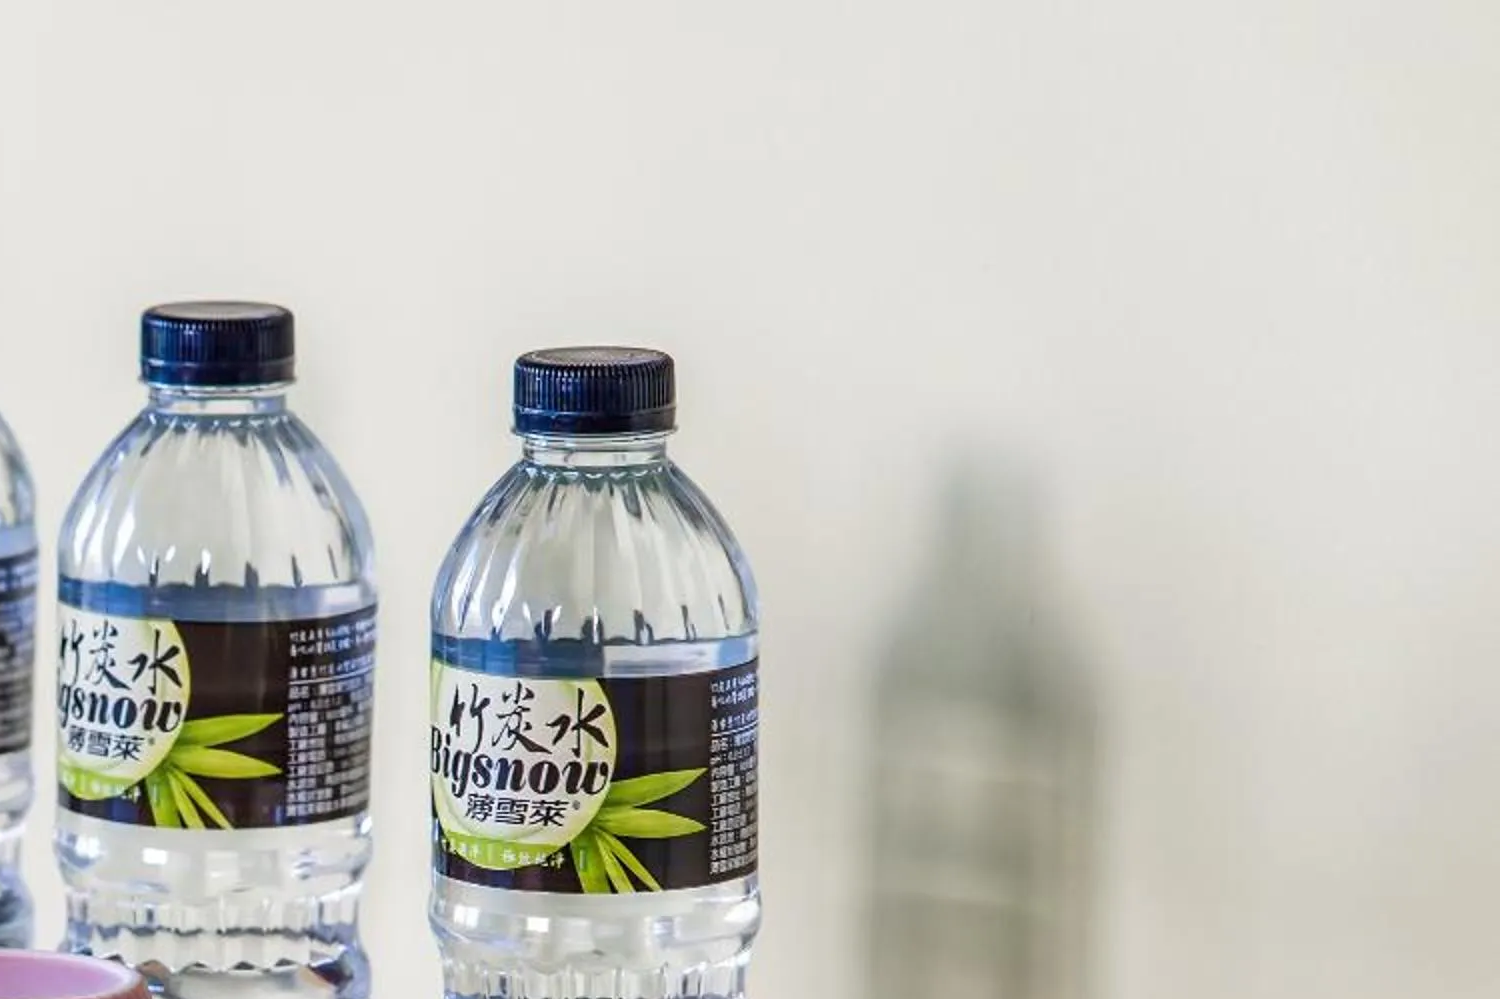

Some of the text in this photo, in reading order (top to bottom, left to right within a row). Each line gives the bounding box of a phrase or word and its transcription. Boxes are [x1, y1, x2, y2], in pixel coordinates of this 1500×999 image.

[58, 682, 183, 733] gsnow
[449, 681, 610, 757] 竹炭水
[431, 725, 609, 798] Bigsnow
[465, 792, 570, 827] 薄雪萊
